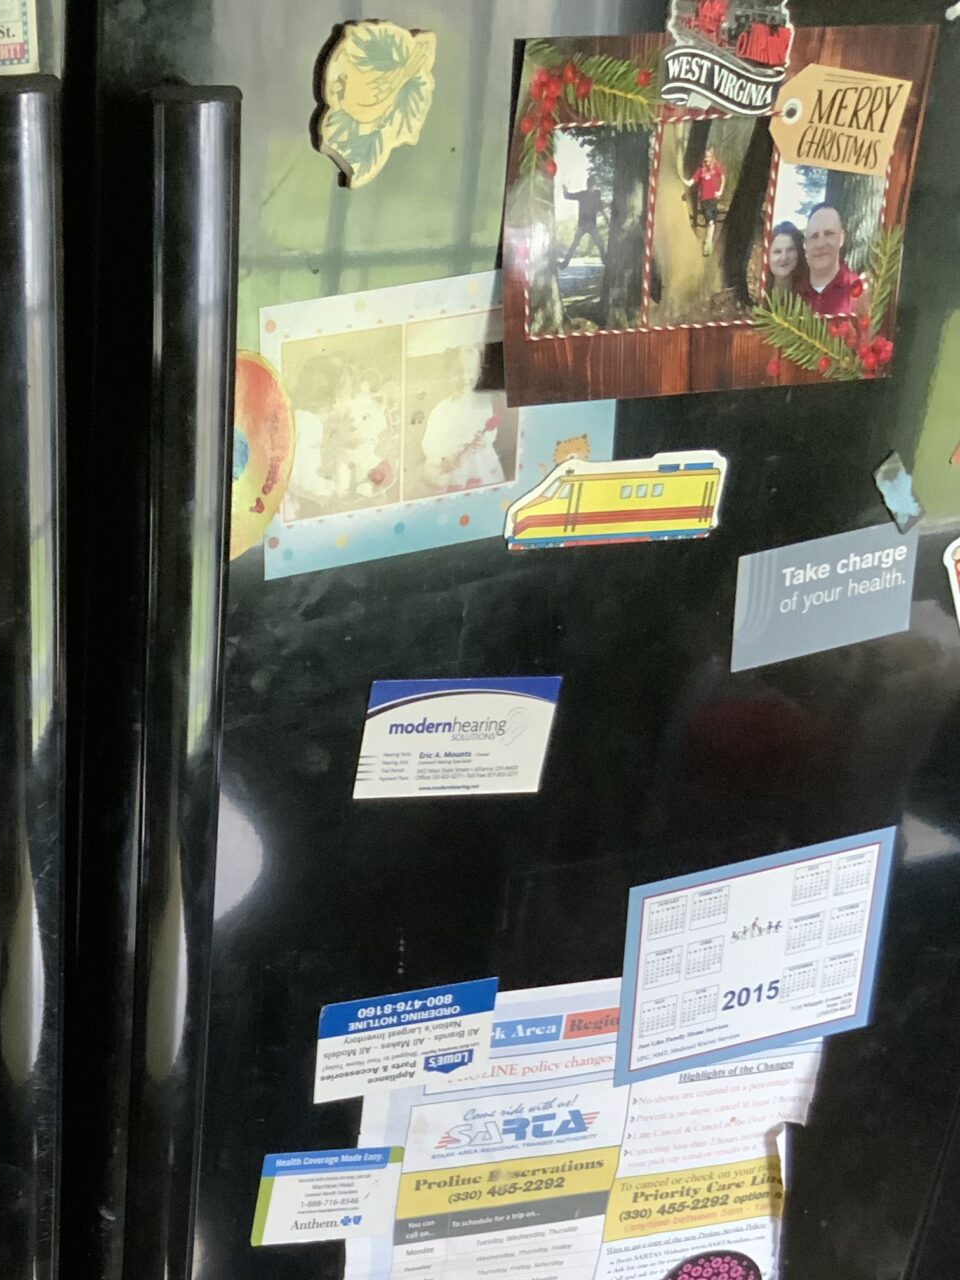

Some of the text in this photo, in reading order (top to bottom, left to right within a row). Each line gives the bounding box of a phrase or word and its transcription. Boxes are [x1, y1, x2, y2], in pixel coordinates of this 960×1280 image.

[667, 56, 774, 106] WEST VIRGINIA
[808, 84, 903, 134] MERRY
[796, 126, 881, 170] CHRISTMAS
[782, 545, 907, 587] Take charge
[779, 568, 906, 613] of your health.
[451, 732, 496, 742] SOLUTIONS
[721, 979, 781, 1012] 2015
[358, 994, 453, 1019] 800-476-8160
[348, 1005, 461, 1032] ORDERING HOTLINE
[344, 1020, 462, 1044] Nation's Largest Inventory
[434, 1030, 465, 1040] Brands
[467, 1028, 480, 1036] All
[512, 1023, 557, 1038] Area
[360, 1046, 372, 1054] All
[380, 1040, 410, 1050] Makes
[412, 1037, 425, 1046] All
[323, 1048, 357, 1059] Models
[428, 1052, 471, 1069] LOWE'S
[320, 1066, 379, 1082] Accessories
[392, 1060, 417, 1070] Parts
[522, 1053, 613, 1078] policy changes
[678, 1060, 795, 1084] Highlights of the Changes
[368, 1070, 416, 1084] Appliance
[275, 1152, 384, 1167] Health Coverage Made Easy.
[415, 1173, 482, 1191] Proline
[448, 1177, 566, 1204] (330) 455-2292
[631, 1186, 701, 1203] Priority
[707, 1178, 746, 1193] Care
[619, 1191, 769, 1222] (330) 455-2292 option
[290, 1218, 337, 1231] Anthem
